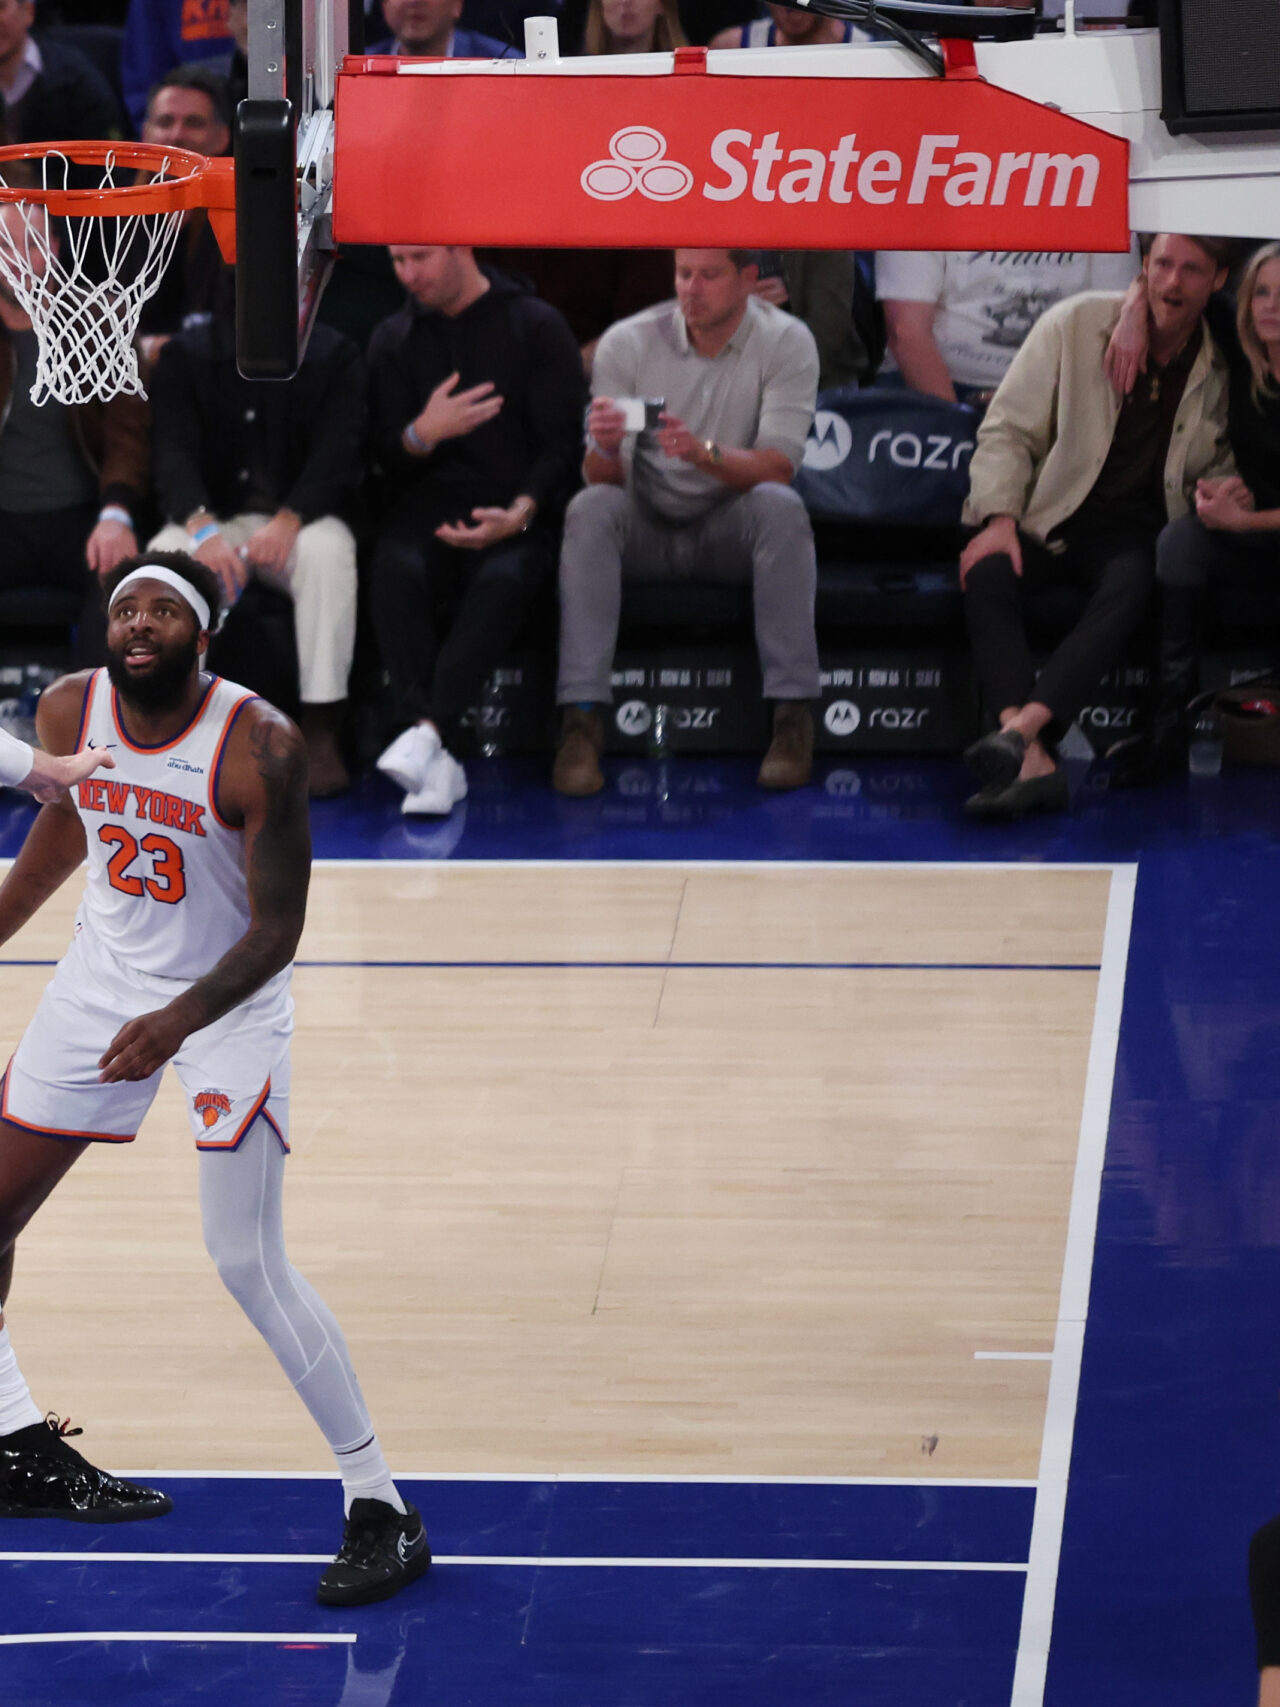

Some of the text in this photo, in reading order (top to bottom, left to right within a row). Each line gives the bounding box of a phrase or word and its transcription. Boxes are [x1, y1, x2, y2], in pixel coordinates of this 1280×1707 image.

[867, 430, 974, 471] razr
[868, 706, 930, 729] razr
[78, 778, 207, 838] NEW YORK
[97, 823, 186, 905] 23
